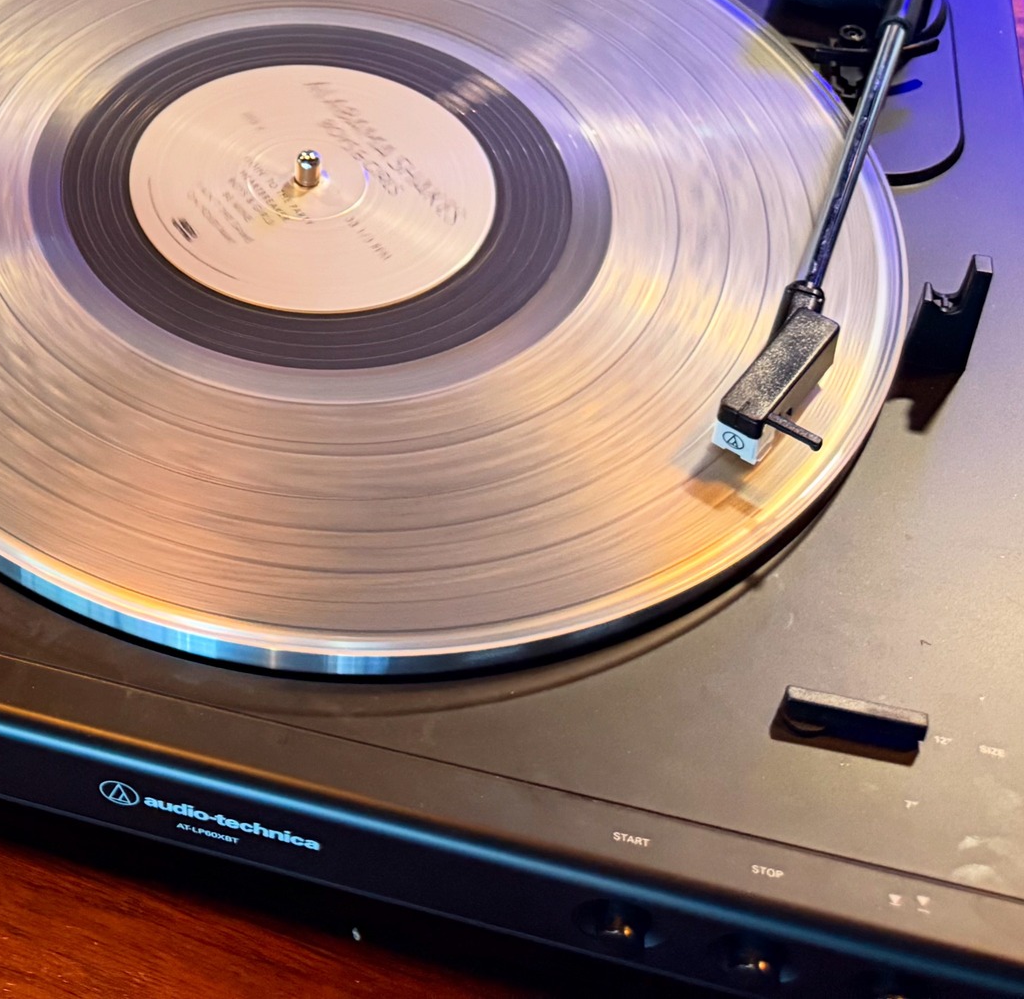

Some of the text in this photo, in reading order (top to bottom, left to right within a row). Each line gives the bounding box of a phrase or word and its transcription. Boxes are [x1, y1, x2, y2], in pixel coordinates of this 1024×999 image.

[979, 744, 1006, 758] SIZE
[143, 796, 321, 851] audio-technica
[612, 831, 652, 847] START
[751, 864, 785, 879] STOP
